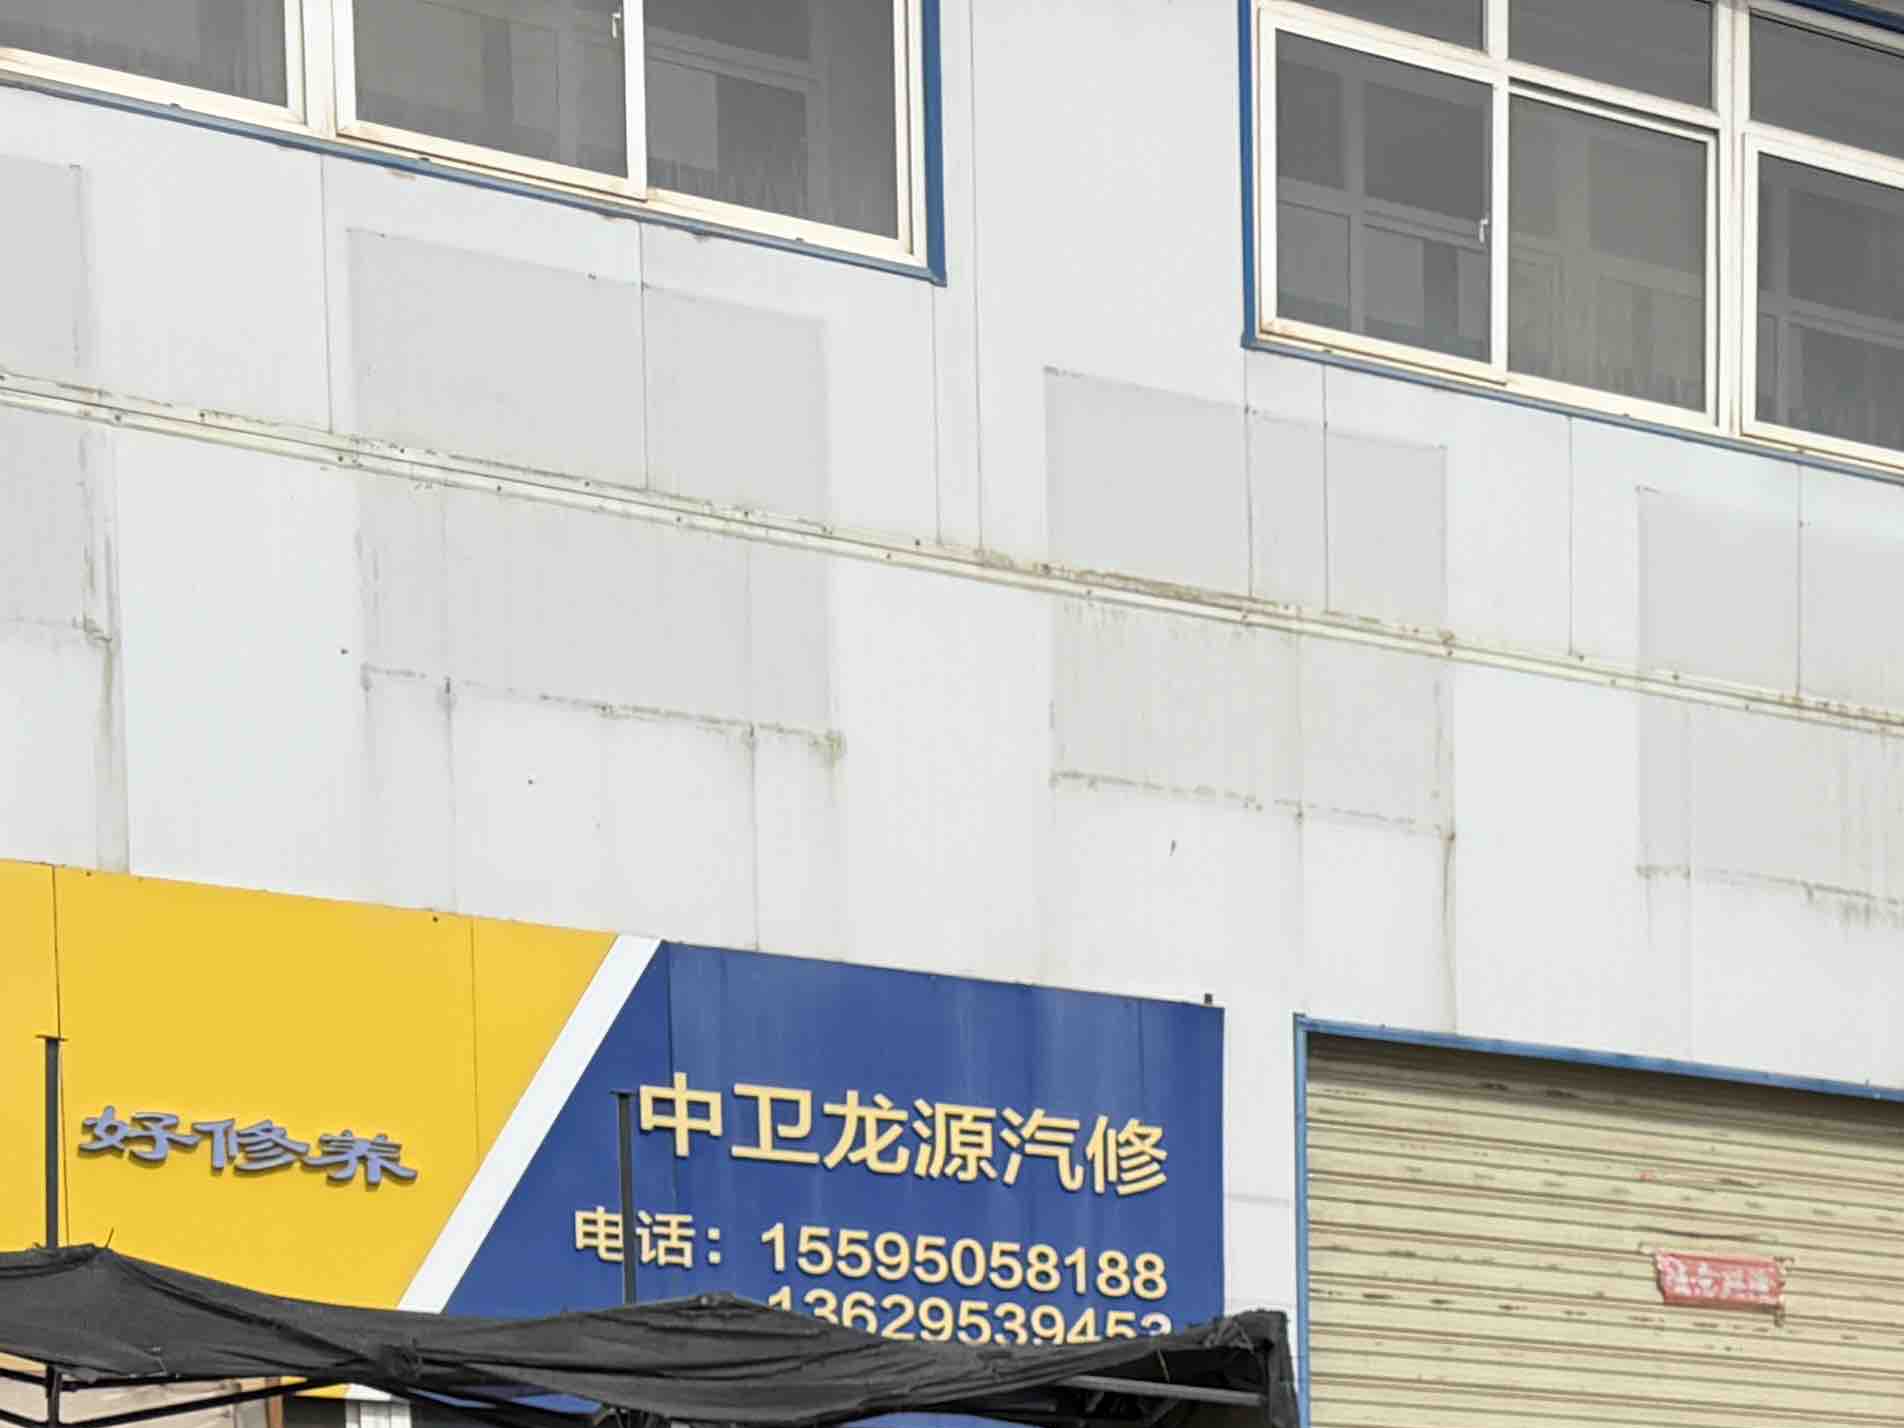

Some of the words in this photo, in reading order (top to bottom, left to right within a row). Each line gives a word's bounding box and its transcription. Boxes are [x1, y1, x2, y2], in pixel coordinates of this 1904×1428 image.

[79, 1105, 418, 1189] 好修养
[639, 1071, 1169, 1196] 中卫龙源汽修
[760, 1222, 1168, 1299] 15595058188
